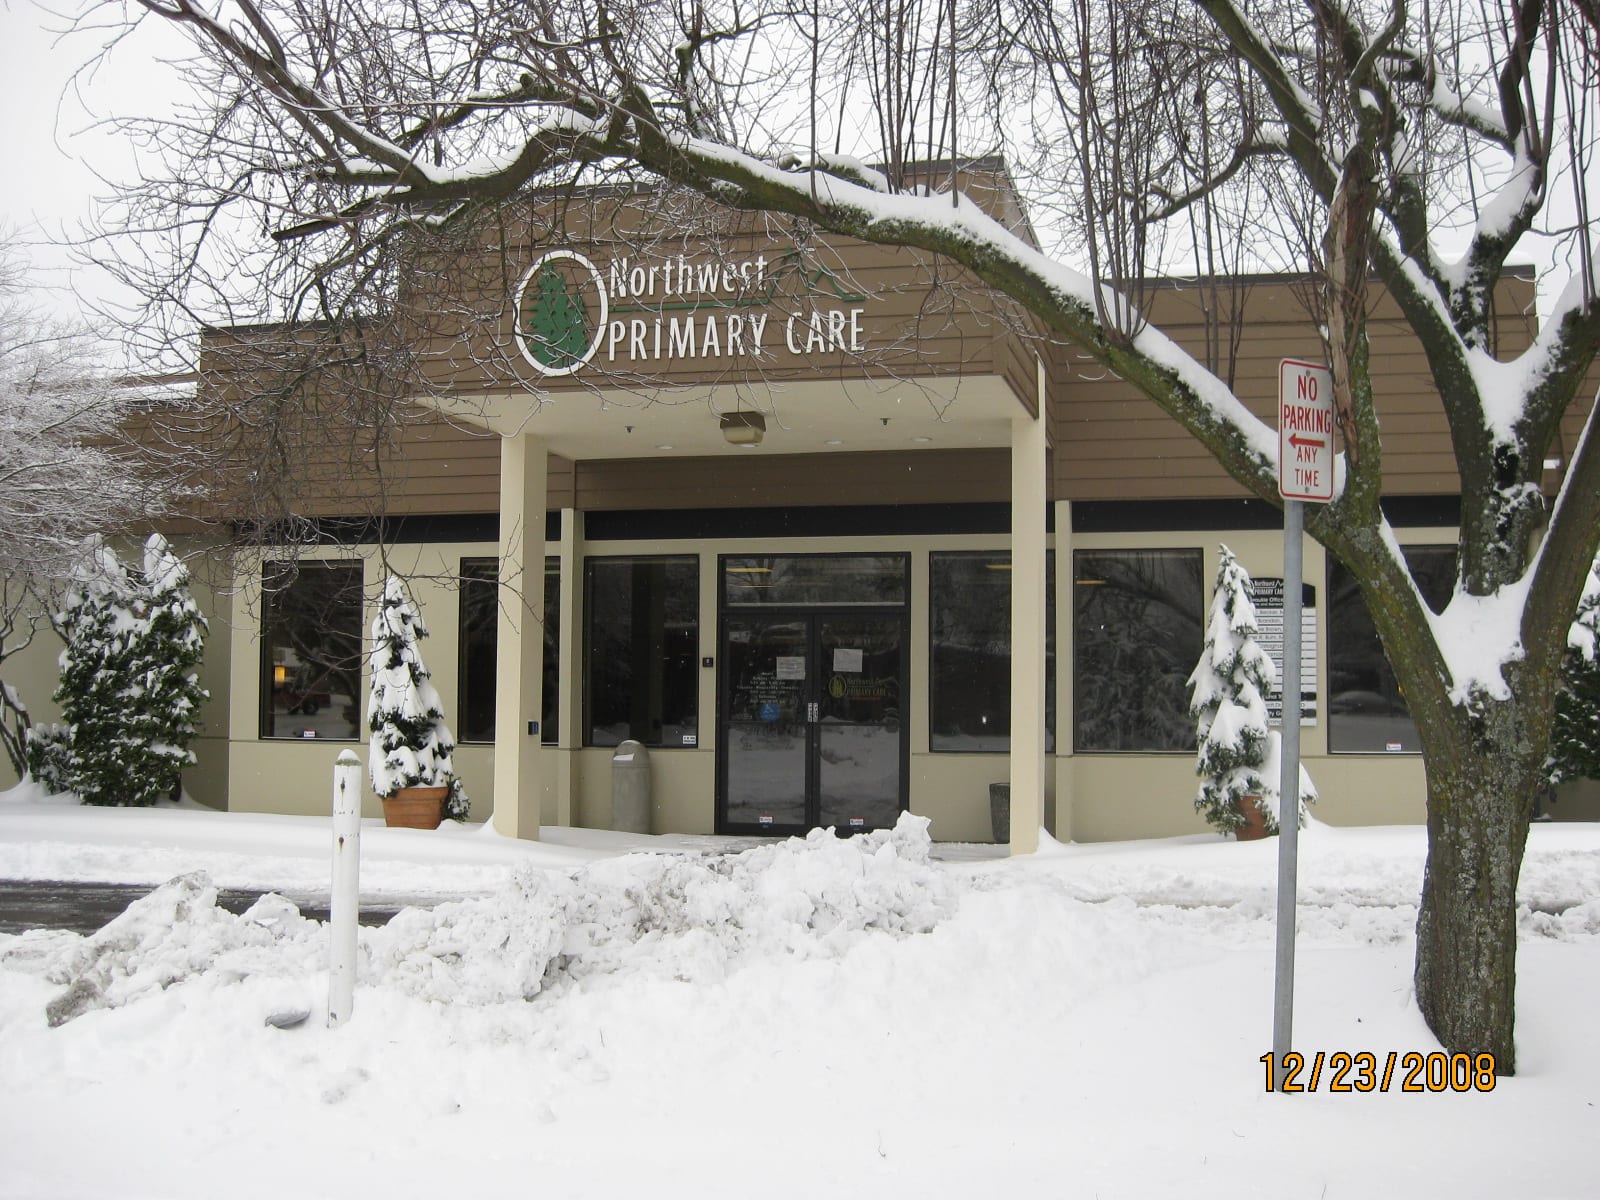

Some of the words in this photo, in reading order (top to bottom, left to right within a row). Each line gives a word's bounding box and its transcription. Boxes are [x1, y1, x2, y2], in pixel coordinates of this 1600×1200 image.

[610, 254, 769, 298] Northwest
[608, 313, 768, 361] PRIMARY
[786, 308, 866, 355] CARE
[1296, 375, 1318, 402] NO
[1283, 404, 1331, 434] PARKING
[1296, 446, 1318, 464] ANY
[1294, 468, 1320, 487] TIME
